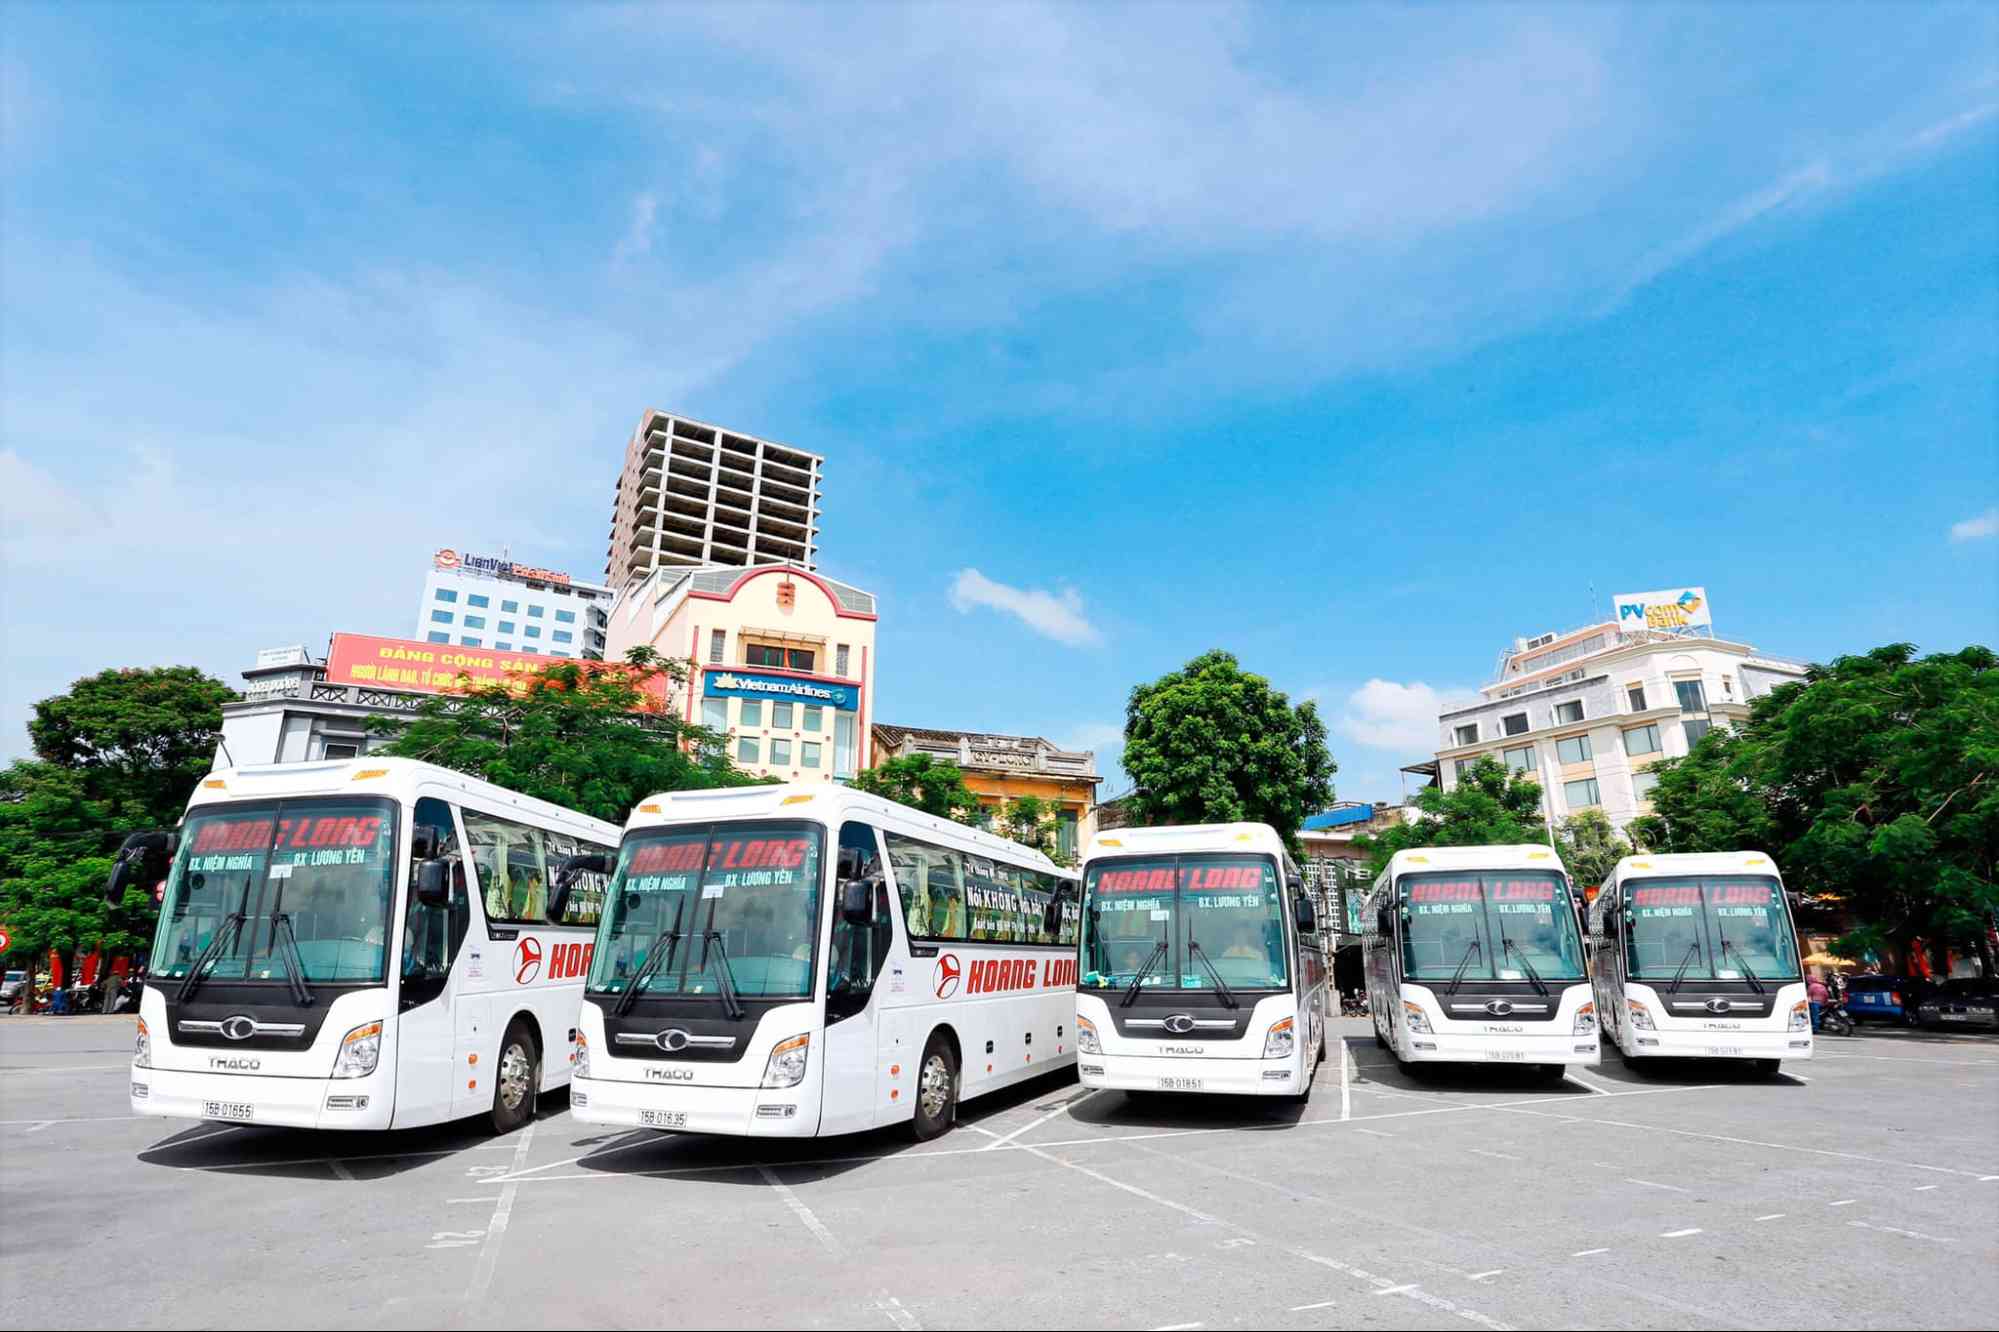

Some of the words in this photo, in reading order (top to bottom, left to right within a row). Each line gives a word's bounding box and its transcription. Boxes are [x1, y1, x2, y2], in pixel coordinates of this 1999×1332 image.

[441, 653, 493, 669] CỘNG
[738, 677, 787, 693] Vietnam
[787, 684, 832, 699] Airlines
[290, 816, 381, 848] LONG
[722, 839, 809, 870] LONG
[1188, 867, 1261, 890] LONG
[984, 887, 1017, 913] KHÔNG
[548, 943, 596, 980] HOA
[966, 959, 1036, 994] HOANG
[208, 1056, 261, 1071] THACO
[643, 1067, 694, 1081] THACO
